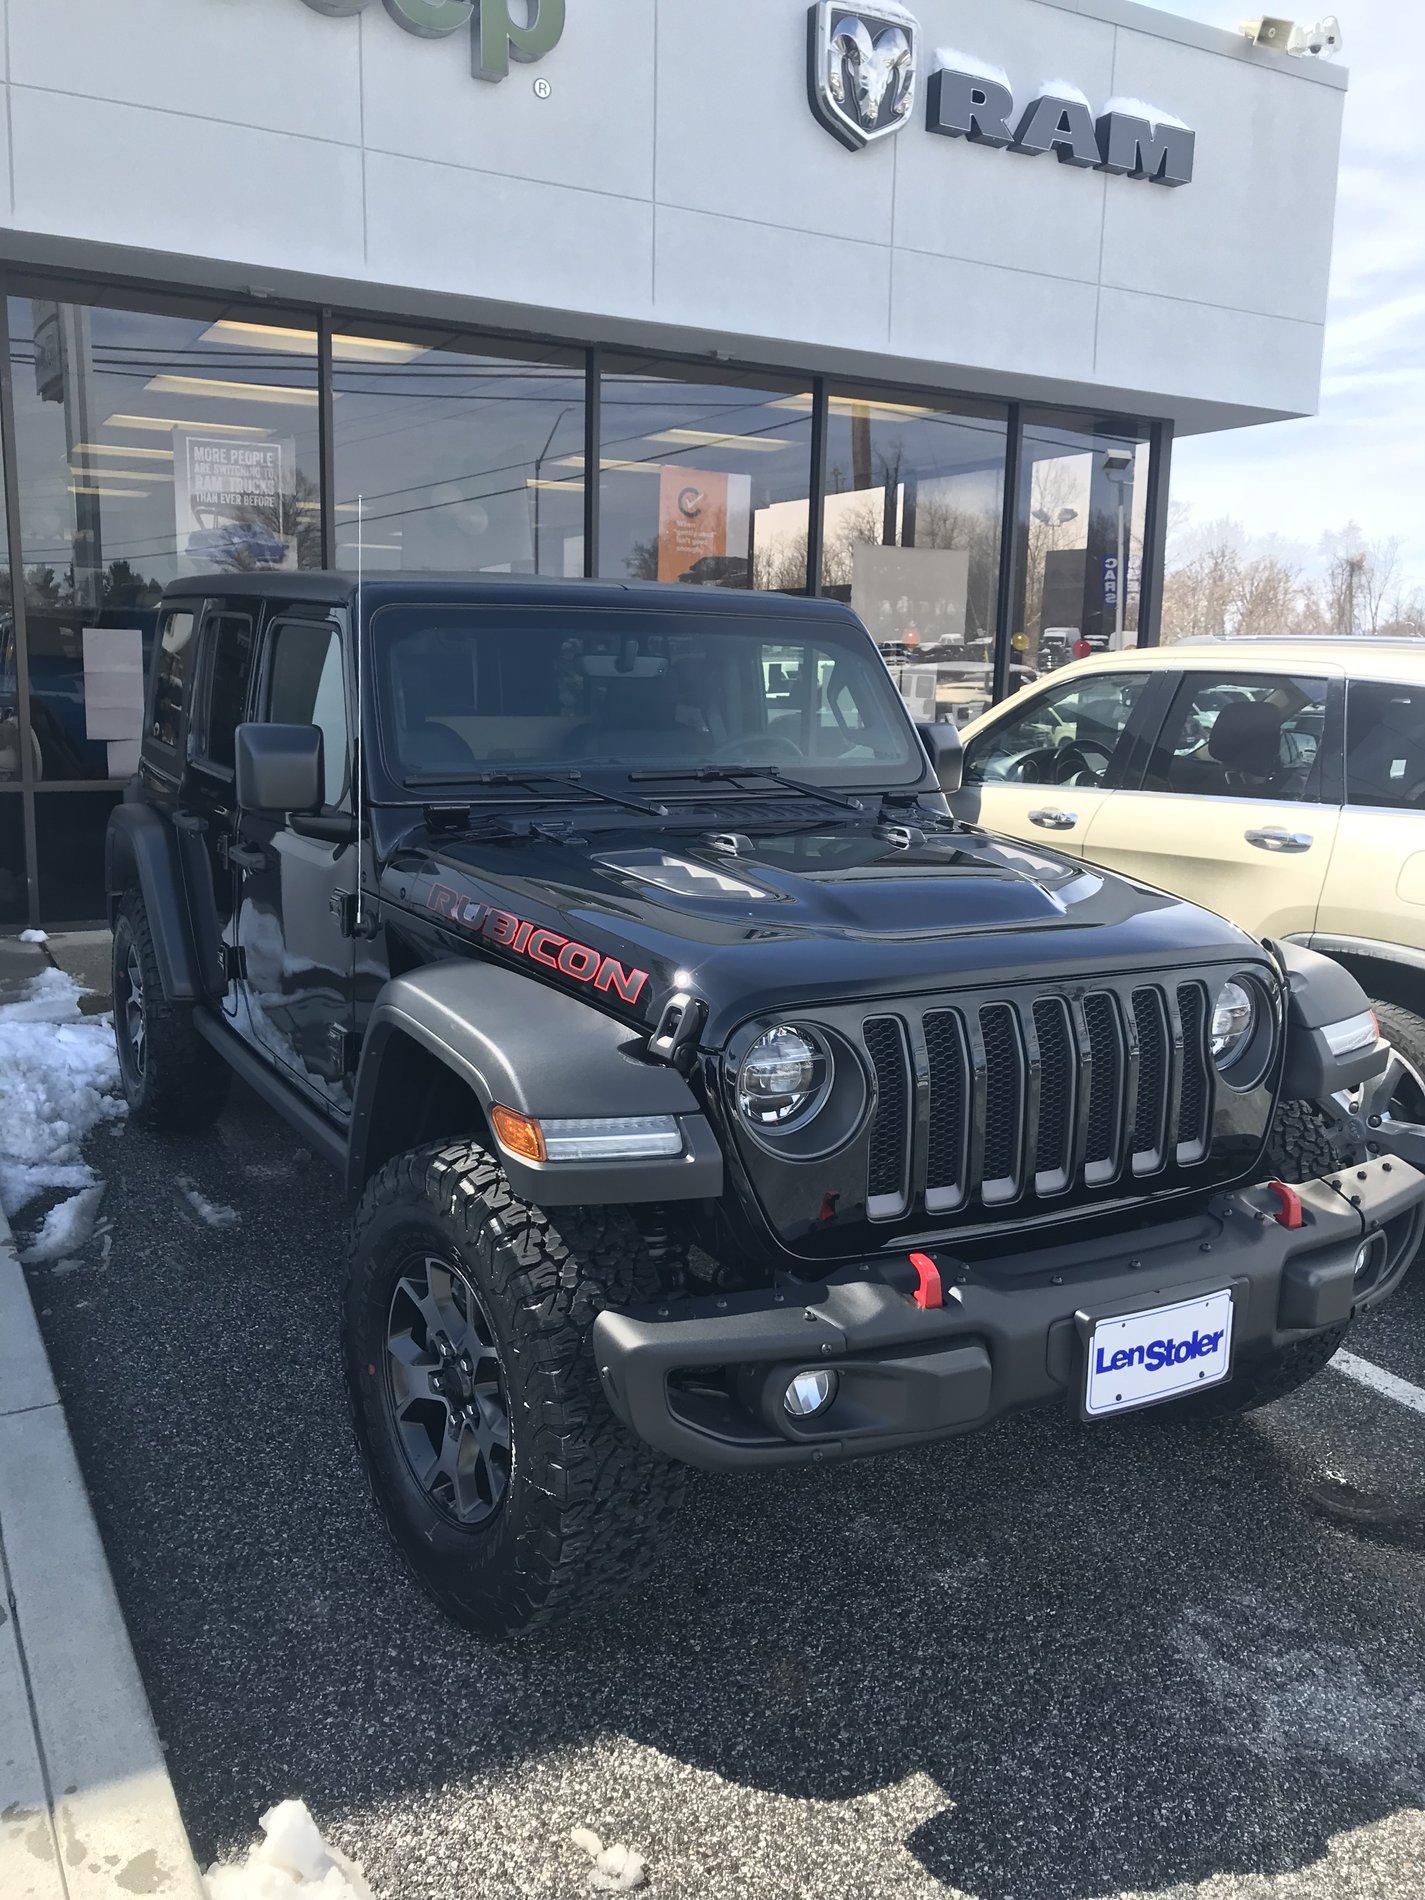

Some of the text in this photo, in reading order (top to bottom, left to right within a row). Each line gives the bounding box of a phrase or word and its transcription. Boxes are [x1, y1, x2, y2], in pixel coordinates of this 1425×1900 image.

[925, 68, 1195, 188] RAM
[194, 447, 274, 466] MORE PEOPLE
[194, 462, 211, 474] ARE
[229, 478, 275, 495] TRUCKS
[196, 493, 275, 508] THAN EVER BEFORE
[427, 883, 649, 1004] RUBICON
